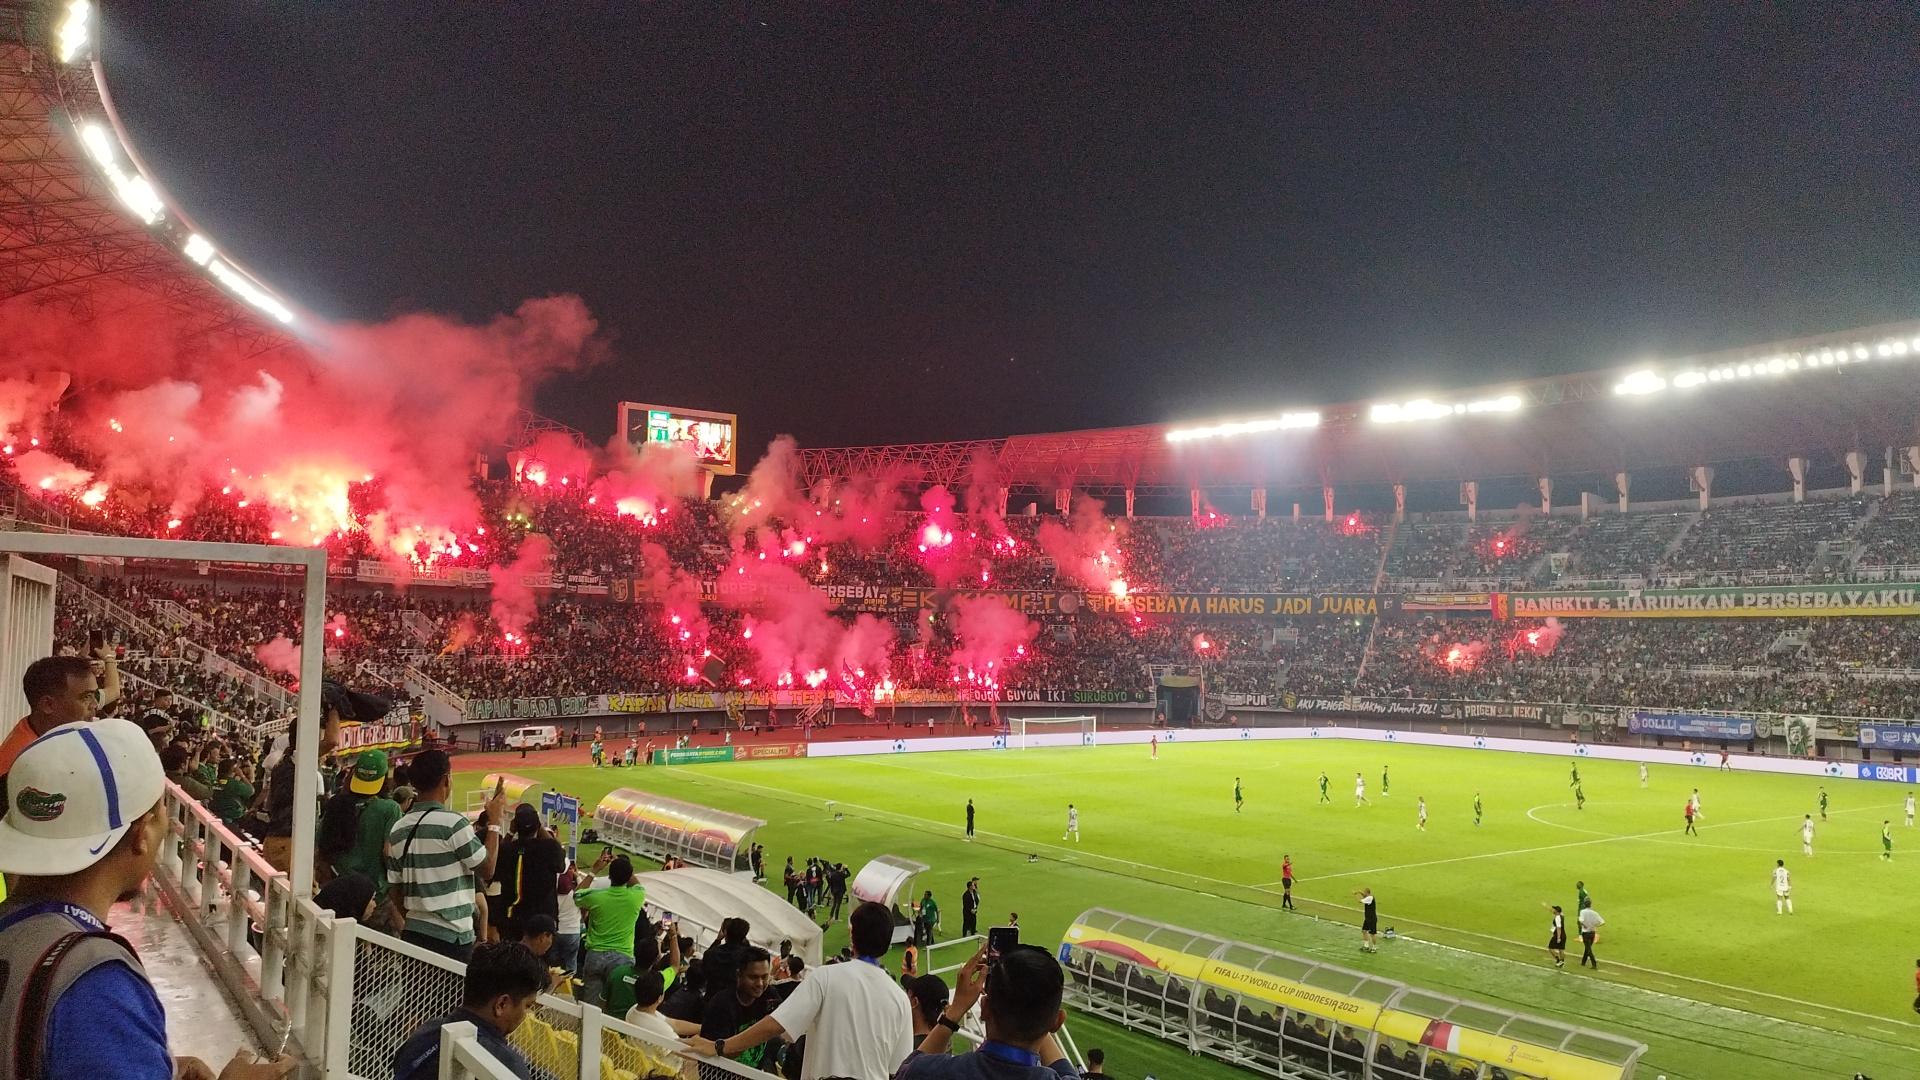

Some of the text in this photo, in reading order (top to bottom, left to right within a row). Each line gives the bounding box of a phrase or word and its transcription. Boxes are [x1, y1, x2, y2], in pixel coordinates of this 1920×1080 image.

[1104, 596, 1378, 615] PERSEBAYA HARUS JADI JUARA
[1515, 597, 1592, 612] BANGKIT
[1617, 593, 1736, 611] HARUMKAN
[1742, 588, 1916, 609] PERSEBAYAKU
[608, 695, 666, 712] KAPAN
[674, 691, 716, 708] KITA
[1006, 689, 1041, 702] GUYON
[1047, 688, 1066, 702] IKI
[1073, 690, 1128, 703] SUROBOYO
[1297, 700, 1315, 710] AKU
[1315, 699, 1345, 711] PENGE
[467, 698, 511, 719] KAPAN
[513, 697, 558, 718] JUARA
[1465, 704, 1544, 720] PRIGEN NEKAT
[1213, 966, 1360, 1014] FIFA U-17 WORLD CUP INDONESIA 2023
